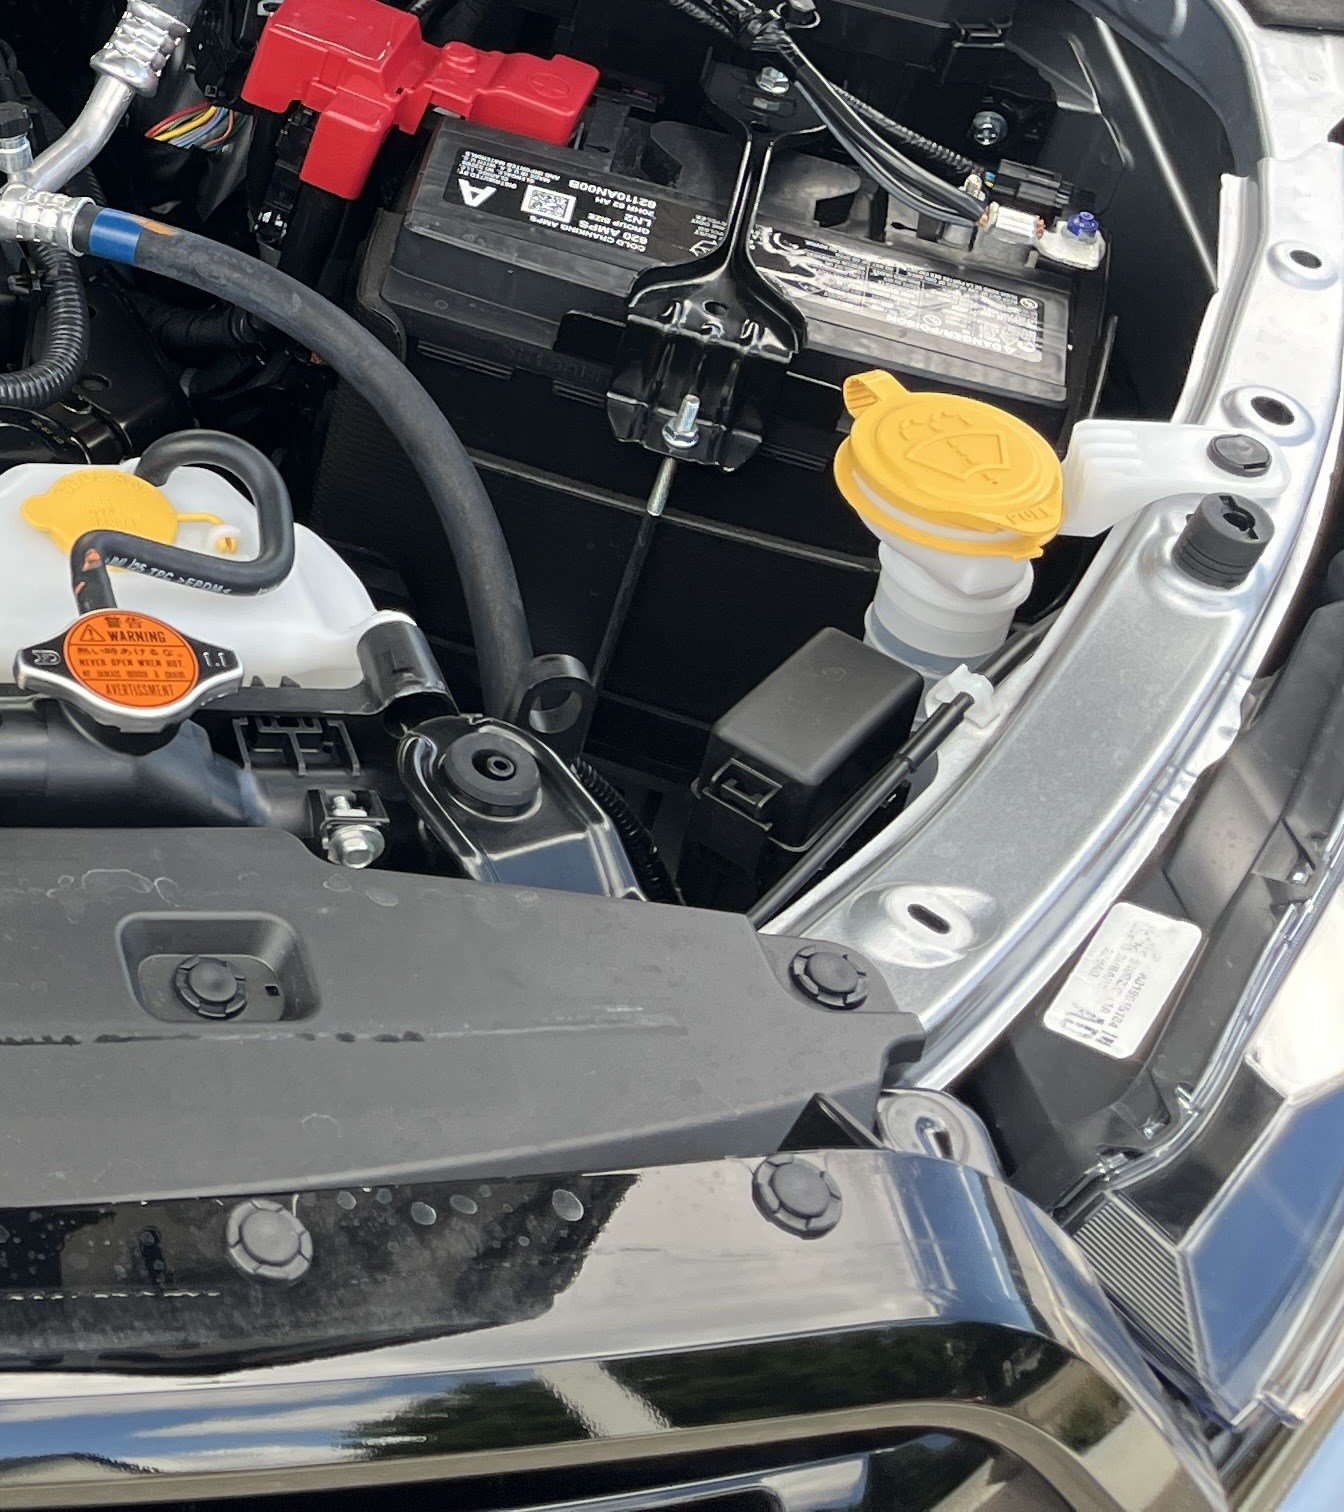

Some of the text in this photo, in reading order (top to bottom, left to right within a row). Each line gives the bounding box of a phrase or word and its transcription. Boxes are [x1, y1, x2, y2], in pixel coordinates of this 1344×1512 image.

[458, 178, 497, 207] A
[578, 220, 621, 237] AMPS
[587, 213, 650, 235] GROUP SIZE
[624, 213, 652, 227] LN2
[529, 215, 646, 252] COLD CRANKING AMPS
[107, 630, 166, 643] WARNING
[79, 659, 107, 667] NEVER
[111, 659, 133, 667] OPEN
[138, 659, 161, 667] WHEN
